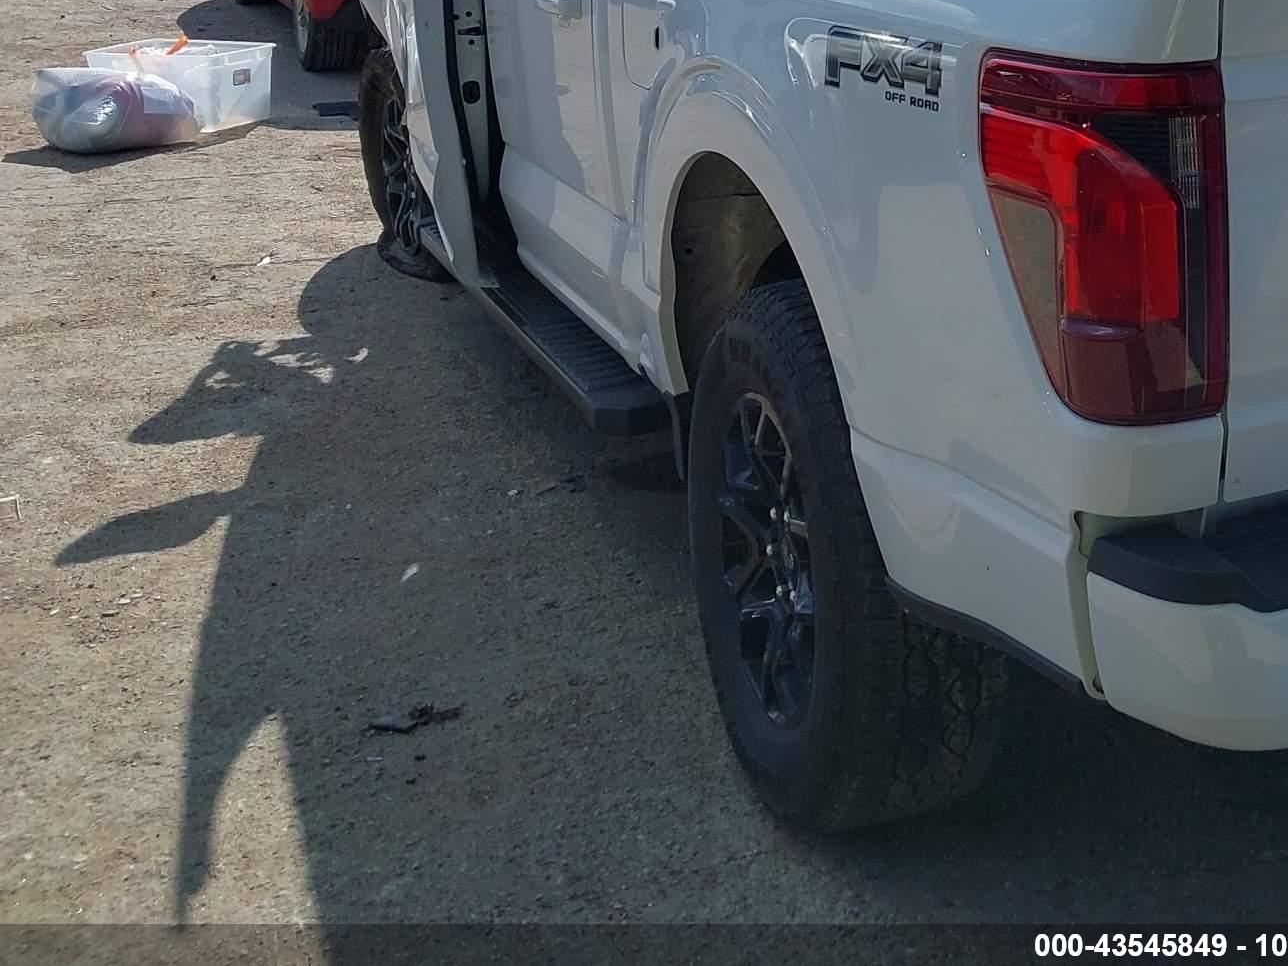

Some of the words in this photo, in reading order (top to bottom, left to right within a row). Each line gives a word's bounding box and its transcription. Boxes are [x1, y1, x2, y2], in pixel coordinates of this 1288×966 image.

[824, 25, 943, 97] FX4
[884, 90, 907, 104] OFF
[909, 96, 940, 112] ROAD
